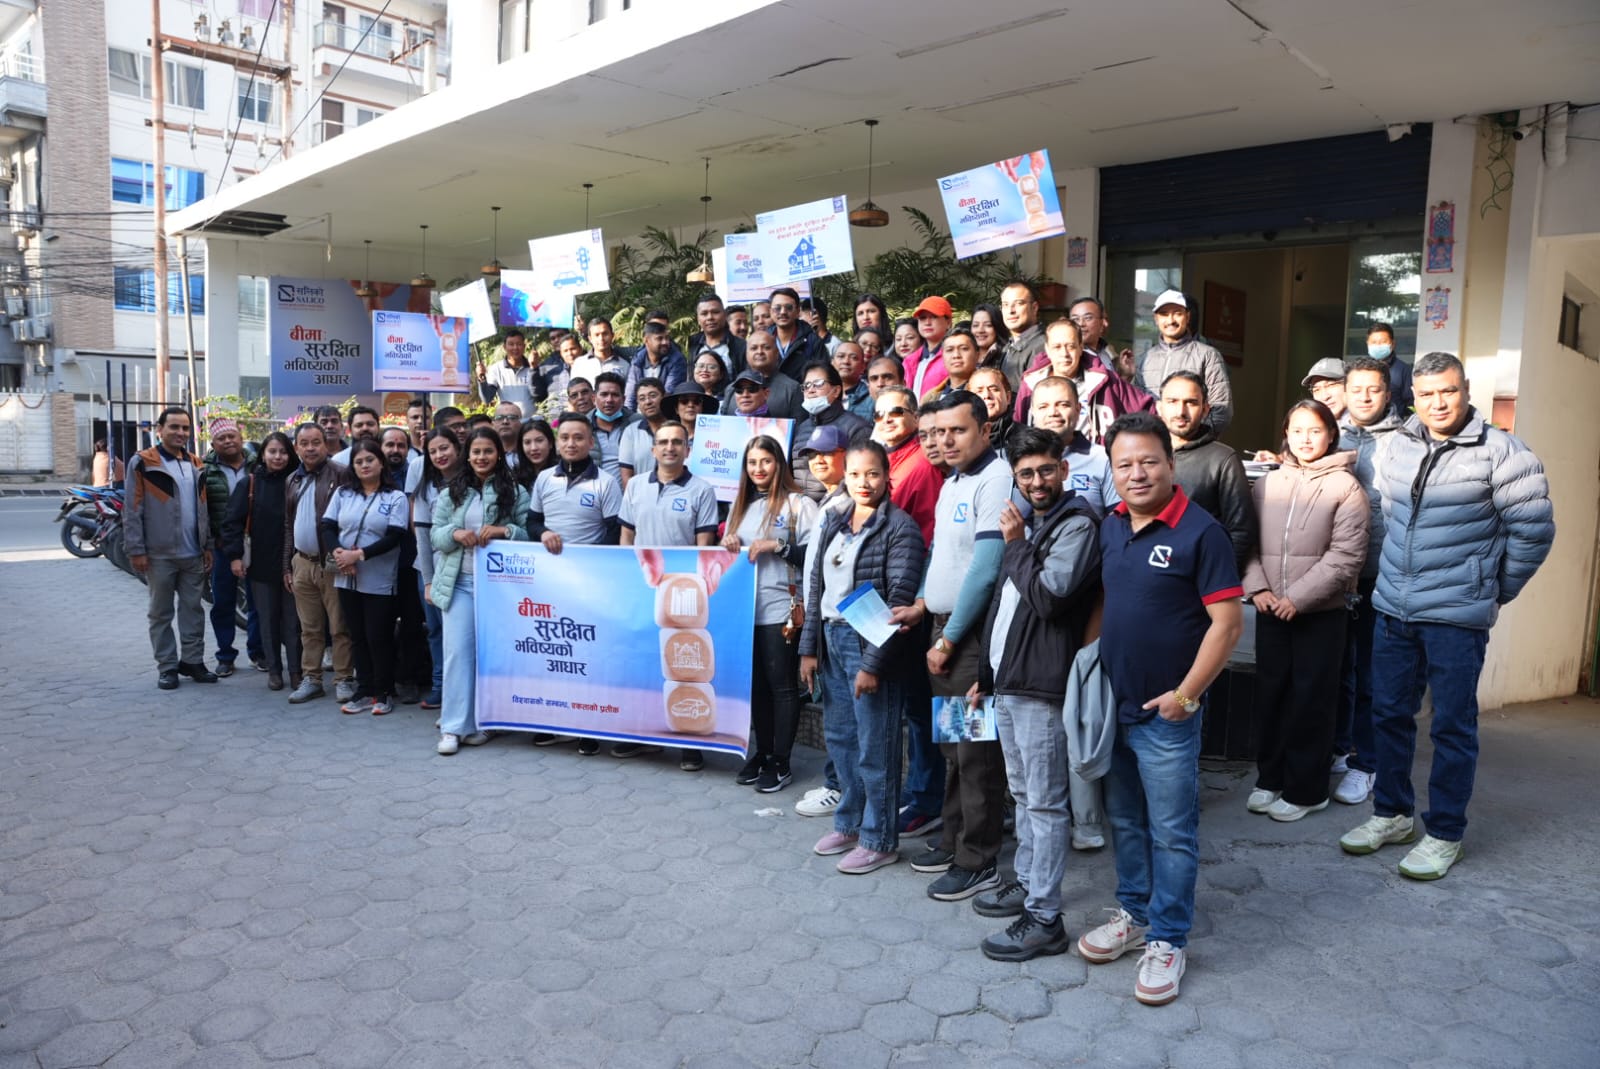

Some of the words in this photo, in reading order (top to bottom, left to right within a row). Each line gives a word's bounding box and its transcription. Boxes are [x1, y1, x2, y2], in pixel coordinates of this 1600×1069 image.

[304, 339, 361, 360] सुरक्षित
[284, 357, 339, 371] भविष्यको
[314, 374, 351, 385] आधार
[505, 567, 535, 575] SALICO
[534, 617, 596, 641] सुरक्षित
[515, 637, 573, 657] भविष्यको
[546, 659, 588, 676] आधार
